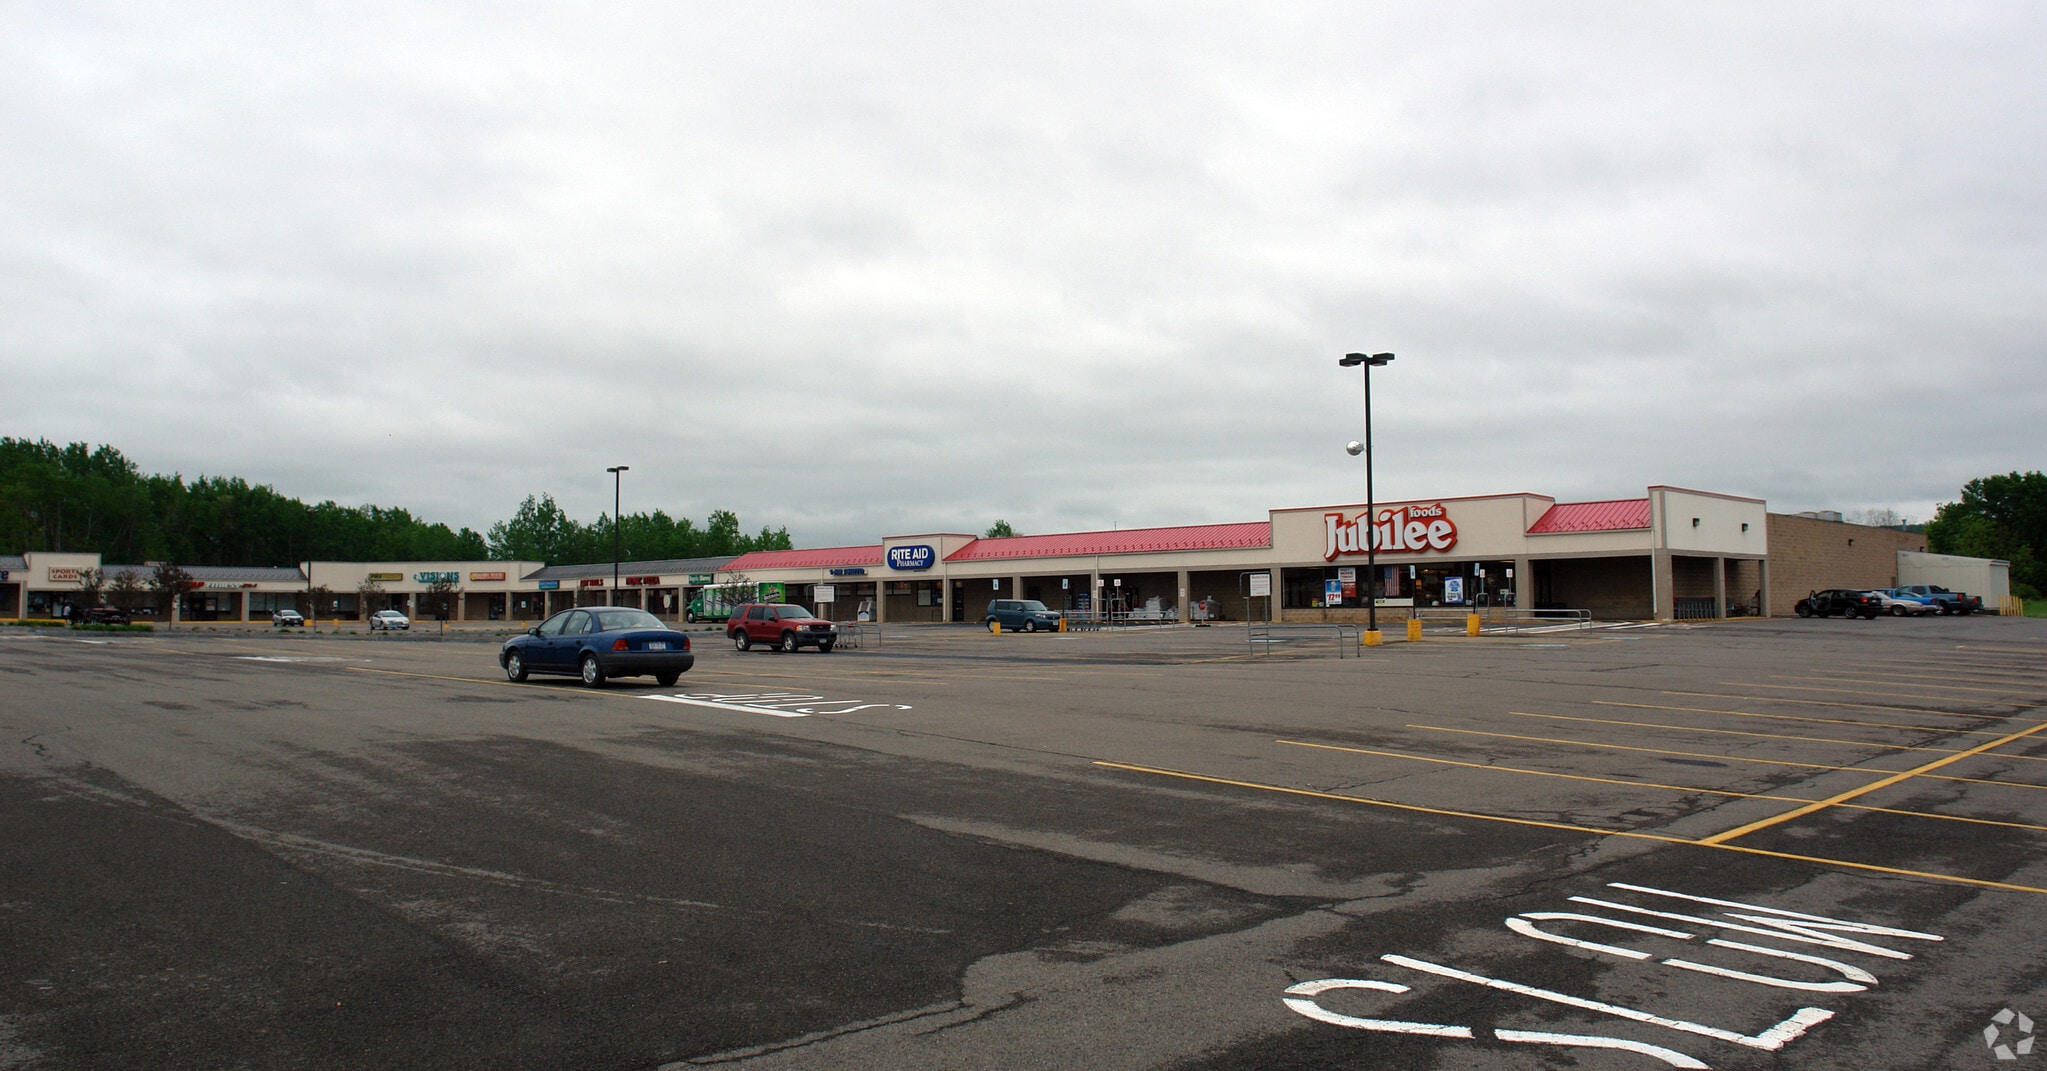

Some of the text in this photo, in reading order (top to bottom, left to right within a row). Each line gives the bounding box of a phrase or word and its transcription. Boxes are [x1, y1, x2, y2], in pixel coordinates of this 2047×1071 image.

[1410, 505, 1442, 517] foods
[1324, 508, 1454, 559] Jubilee
[891, 548, 929, 560] RITE AID
[896, 559, 924, 567] PHARMACY
[419, 571, 460, 580] VISIONS
[1283, 882, 1944, 1070] SLOW
